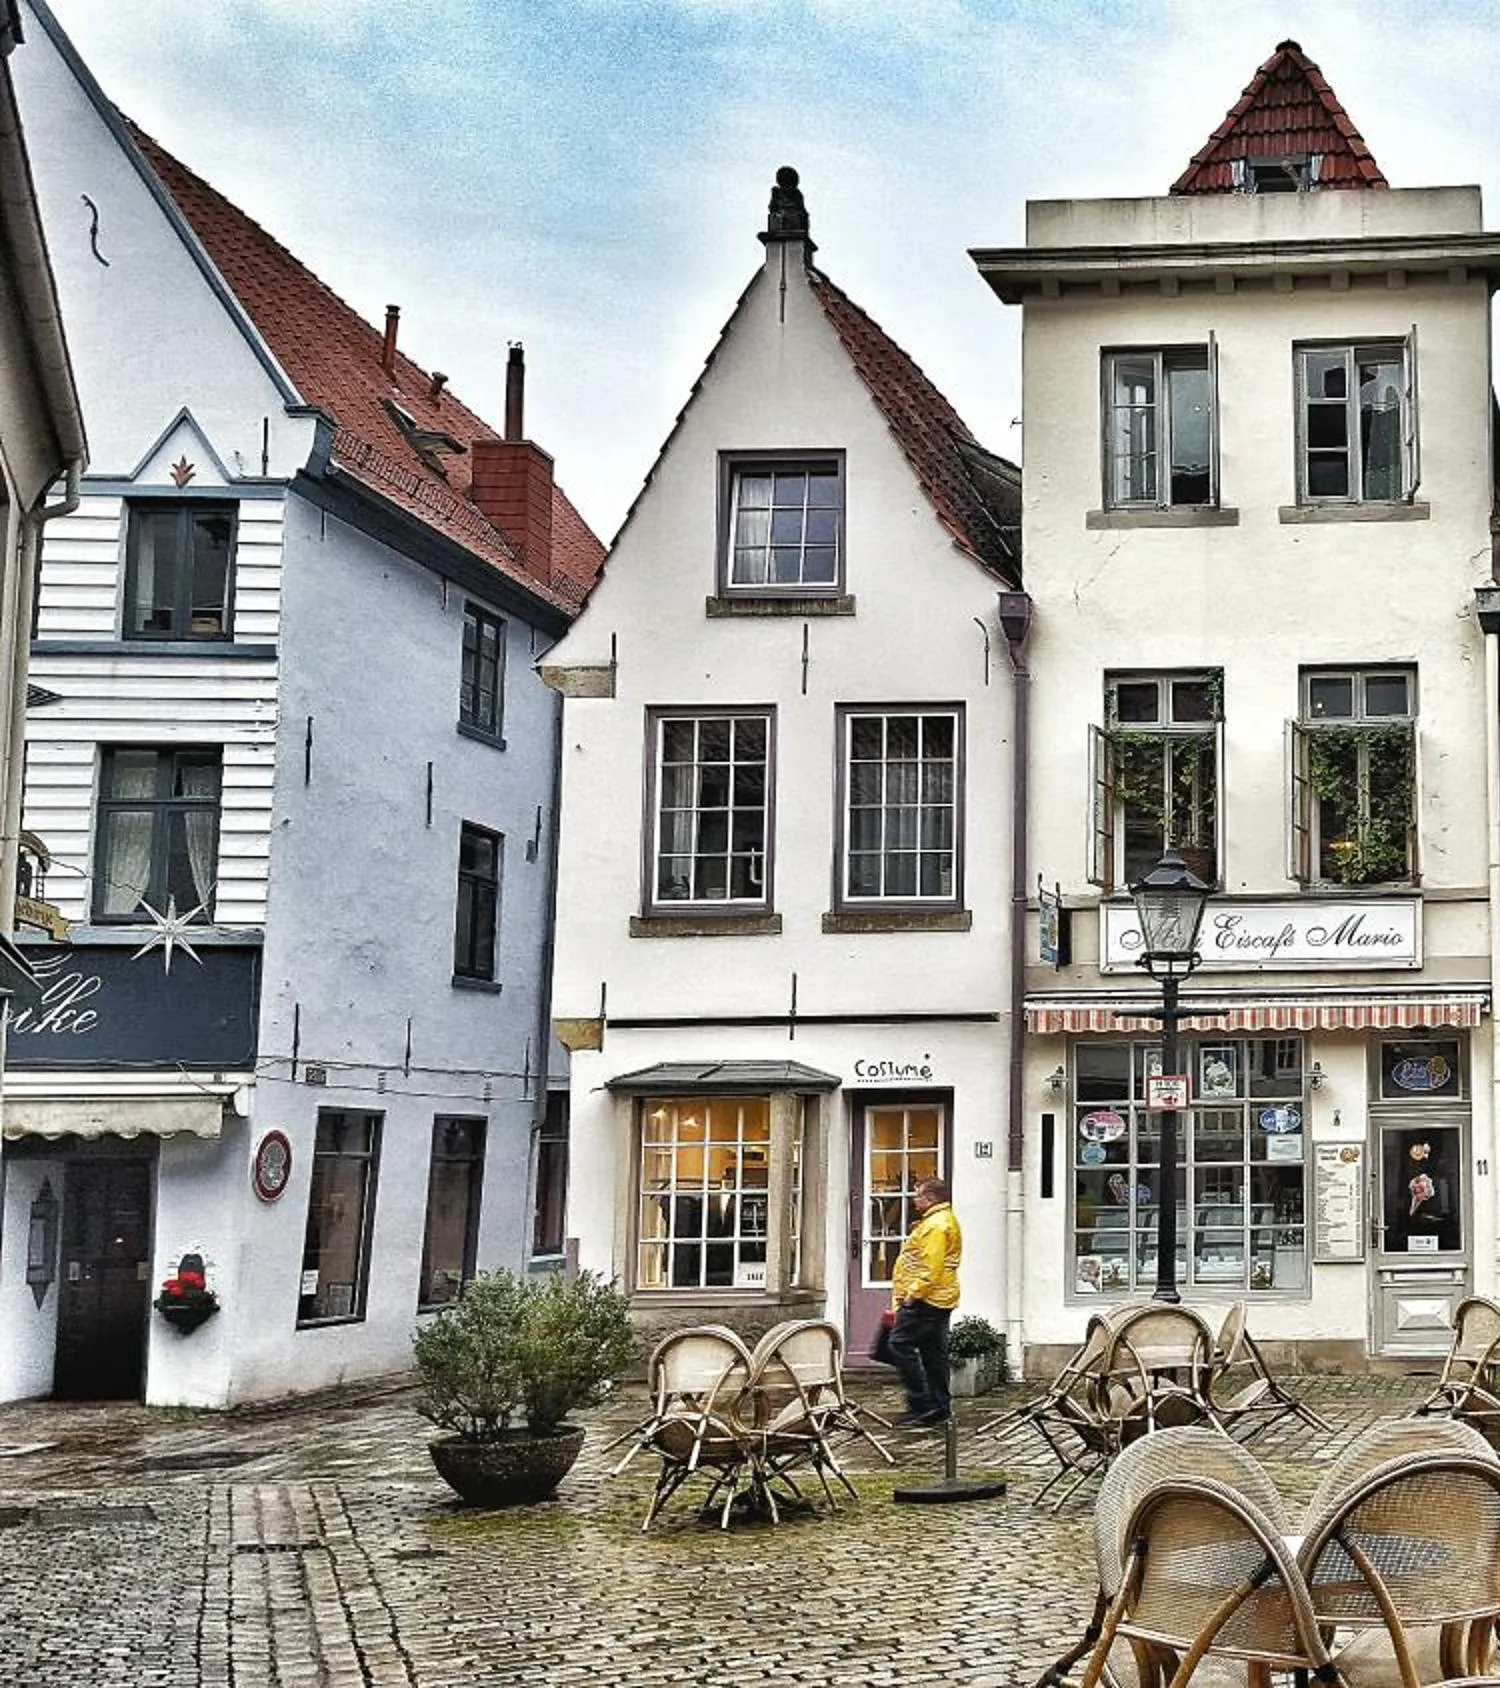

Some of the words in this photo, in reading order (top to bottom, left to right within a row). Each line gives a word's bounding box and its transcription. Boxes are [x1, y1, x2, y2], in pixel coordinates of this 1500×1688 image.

[1213, 912, 1298, 957] Eiscafé
[1305, 912, 1405, 948] Mario
[1476, 1160, 1488, 1175] 11
